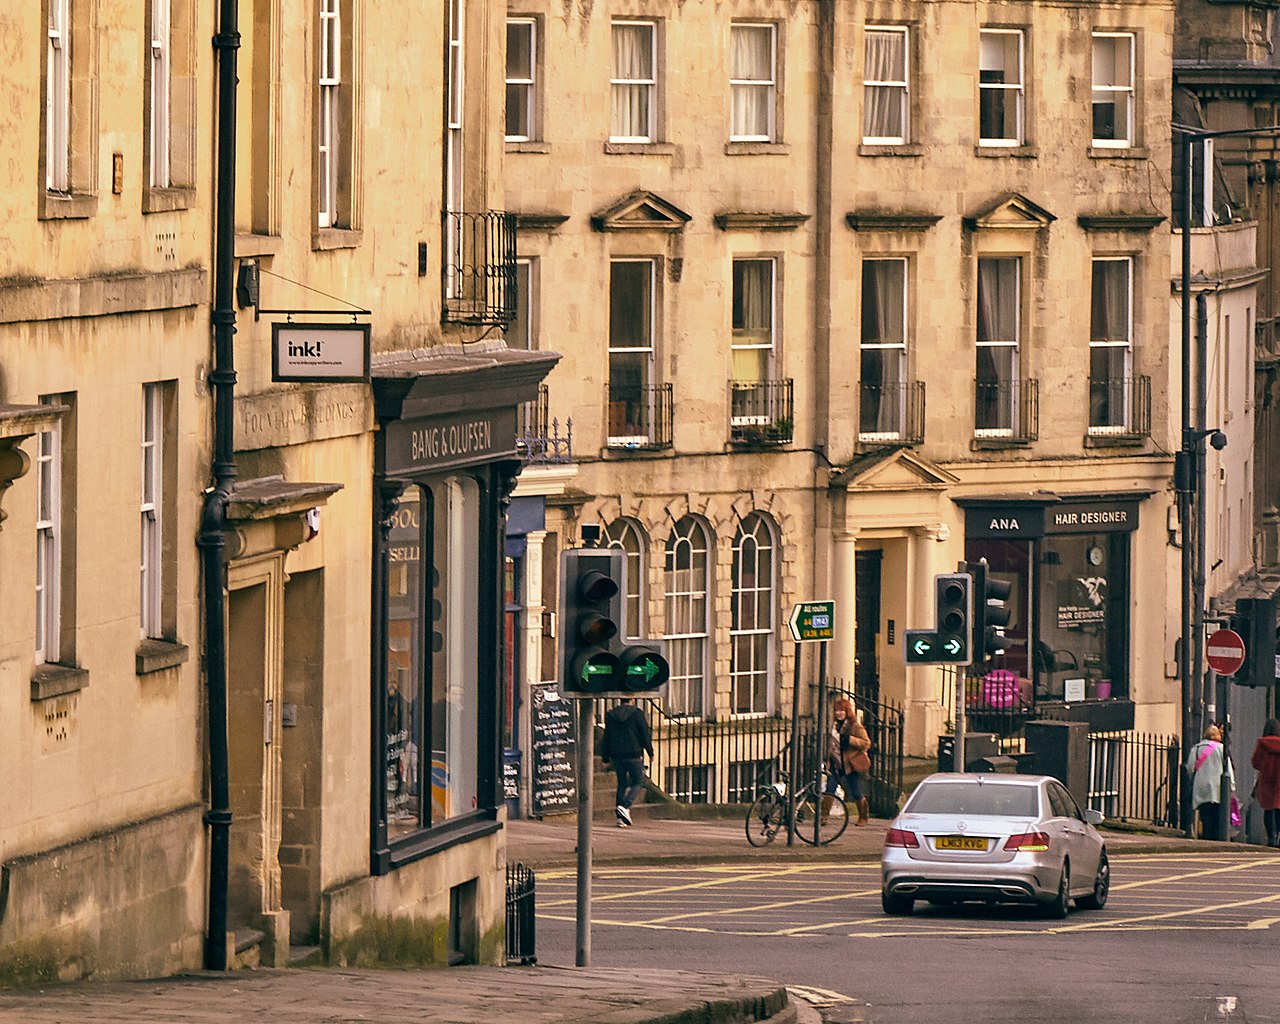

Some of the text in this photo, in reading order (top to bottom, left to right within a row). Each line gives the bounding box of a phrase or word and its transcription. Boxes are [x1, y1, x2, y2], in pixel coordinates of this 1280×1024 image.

[287, 341, 321, 357] ink!
[244, 409, 297, 434] FOUNTAIN
[411, 420, 491, 461] BANG & OLUFSEN
[989, 511, 1128, 530] ANA HAIR DESIGNER
[1073, 610, 1105, 619] DESIGNER
